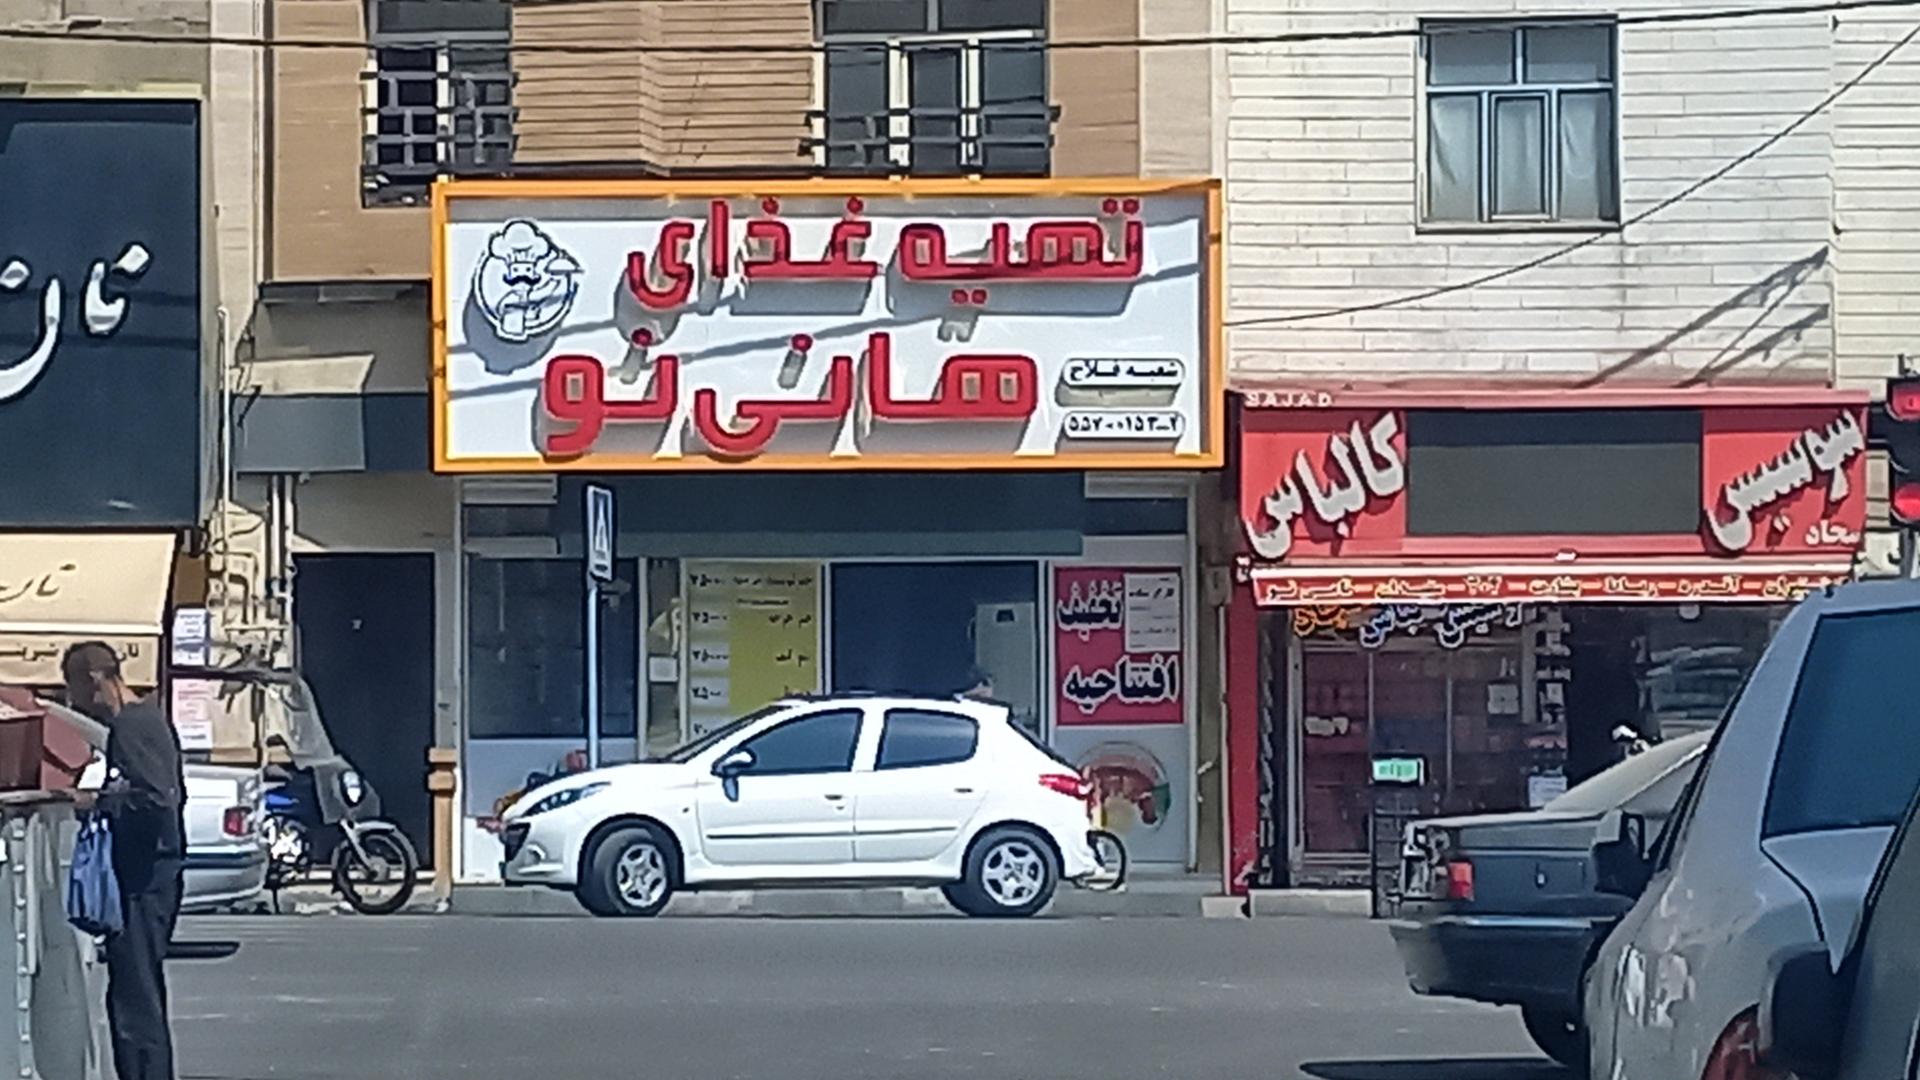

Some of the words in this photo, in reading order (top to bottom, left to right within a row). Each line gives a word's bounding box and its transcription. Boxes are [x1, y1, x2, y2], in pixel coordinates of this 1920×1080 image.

[627, 195, 879, 309] غذای
[901, 197, 1144, 305] تهیه
[543, 329, 679, 456] نو
[695, 332, 1038, 456] هانی
[1070, 358, 1121, 382] فلاح
[1125, 361, 1178, 382] شعبه
[1244, 391, 1333, 407] SAJAD
[1245, 411, 1407, 560] کالباس
[1706, 408, 1866, 551] سوسیس
[1057, 580, 1123, 641] تخفیف
[1062, 653, 1180, 714] افتتاحیه
